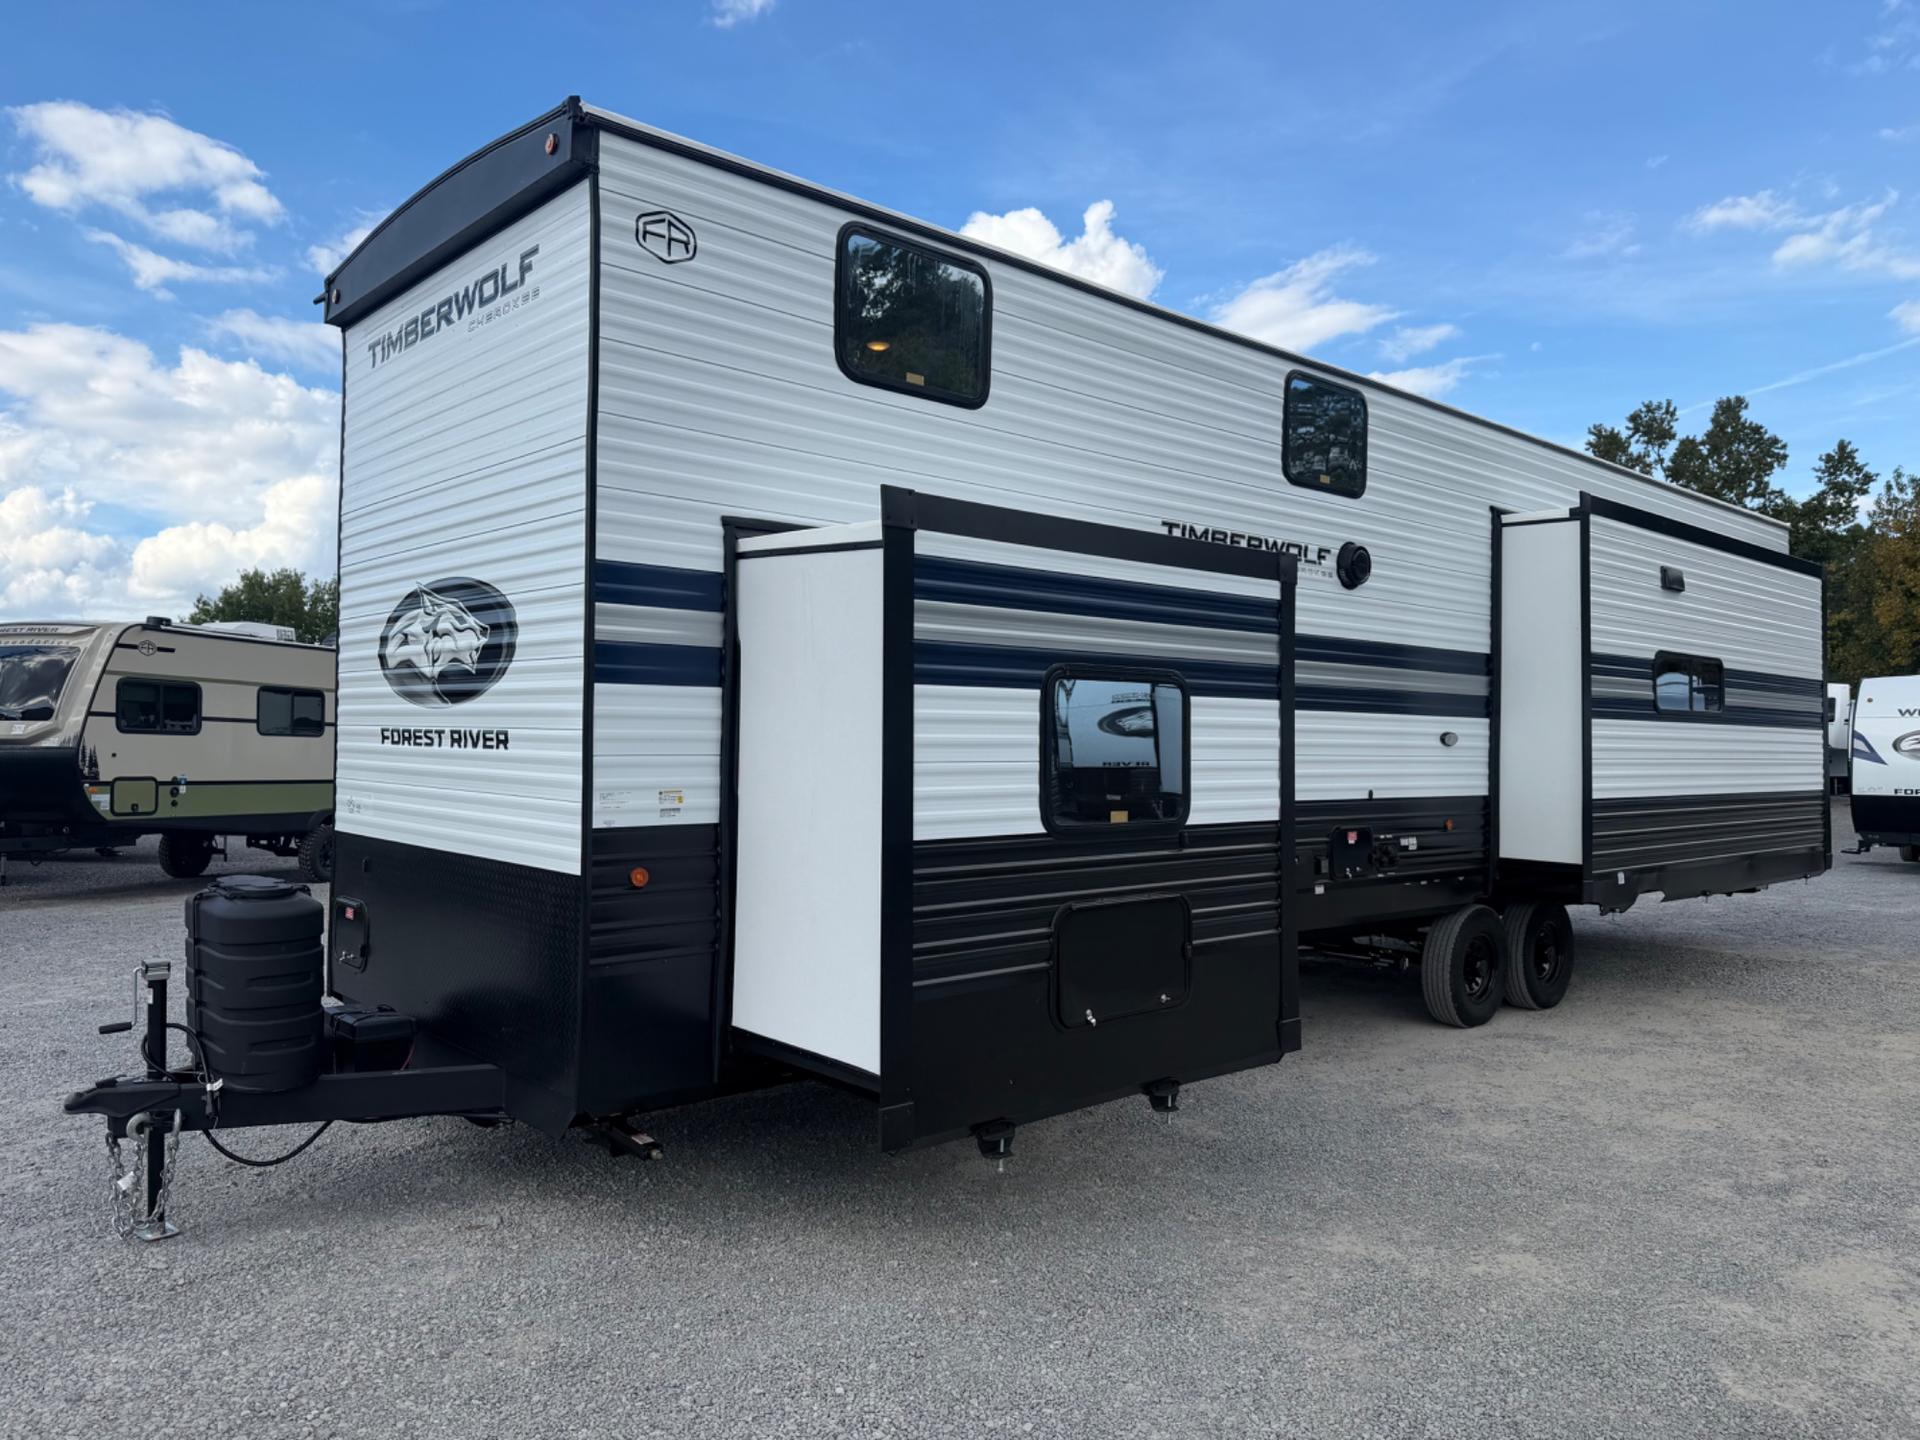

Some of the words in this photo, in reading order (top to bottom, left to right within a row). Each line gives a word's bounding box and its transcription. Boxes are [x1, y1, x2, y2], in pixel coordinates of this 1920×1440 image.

[368, 244, 540, 368] TIMBERWOLF
[467, 286, 541, 333] CHEROKEE
[1161, 520, 1331, 566] TIMBERWOLF
[380, 728, 445, 748] FOREST
[450, 730, 509, 750] RIVER
